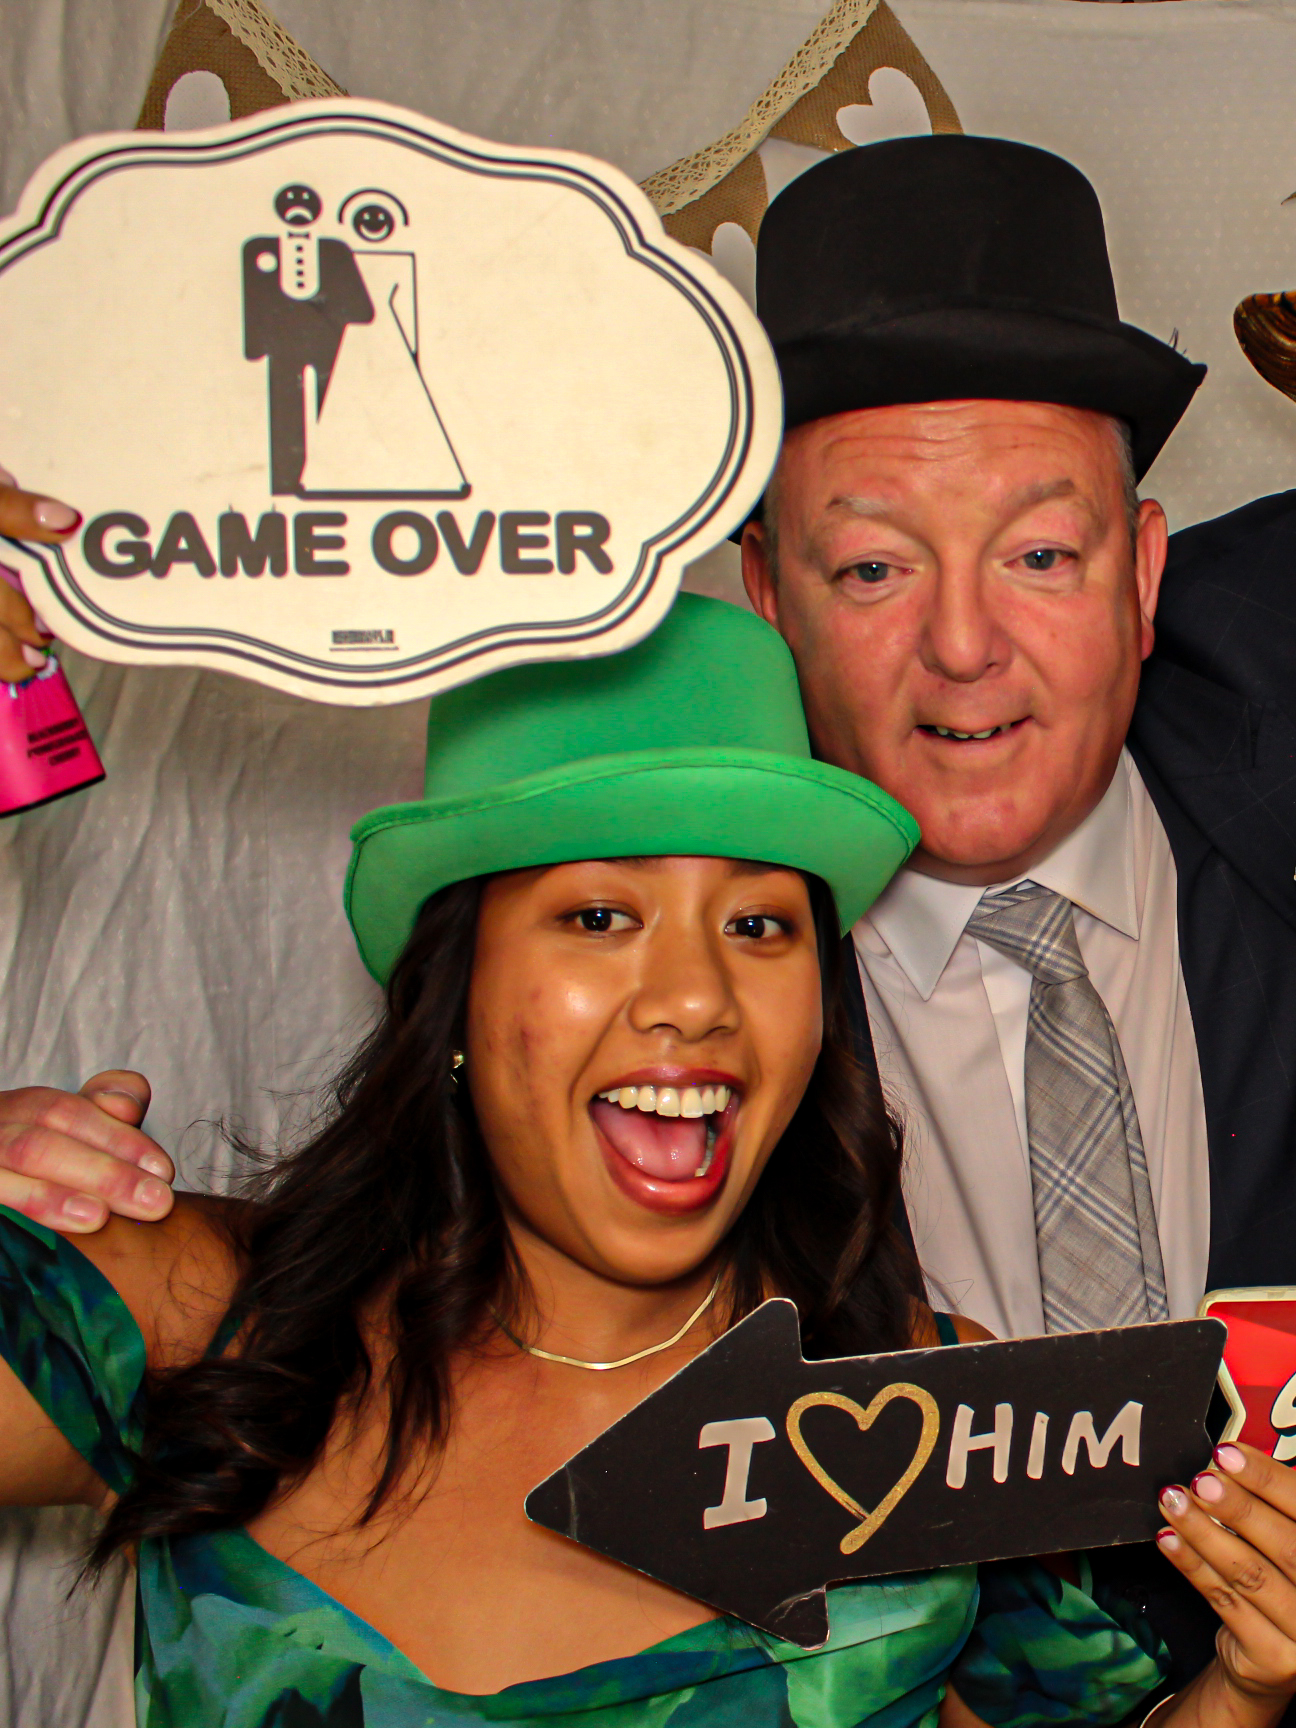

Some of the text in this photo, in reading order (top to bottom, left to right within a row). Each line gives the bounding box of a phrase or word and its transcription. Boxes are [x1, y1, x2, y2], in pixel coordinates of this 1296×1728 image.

[81, 509, 614, 578] GAME OVER
[698, 1401, 1143, 1530] I HIM
